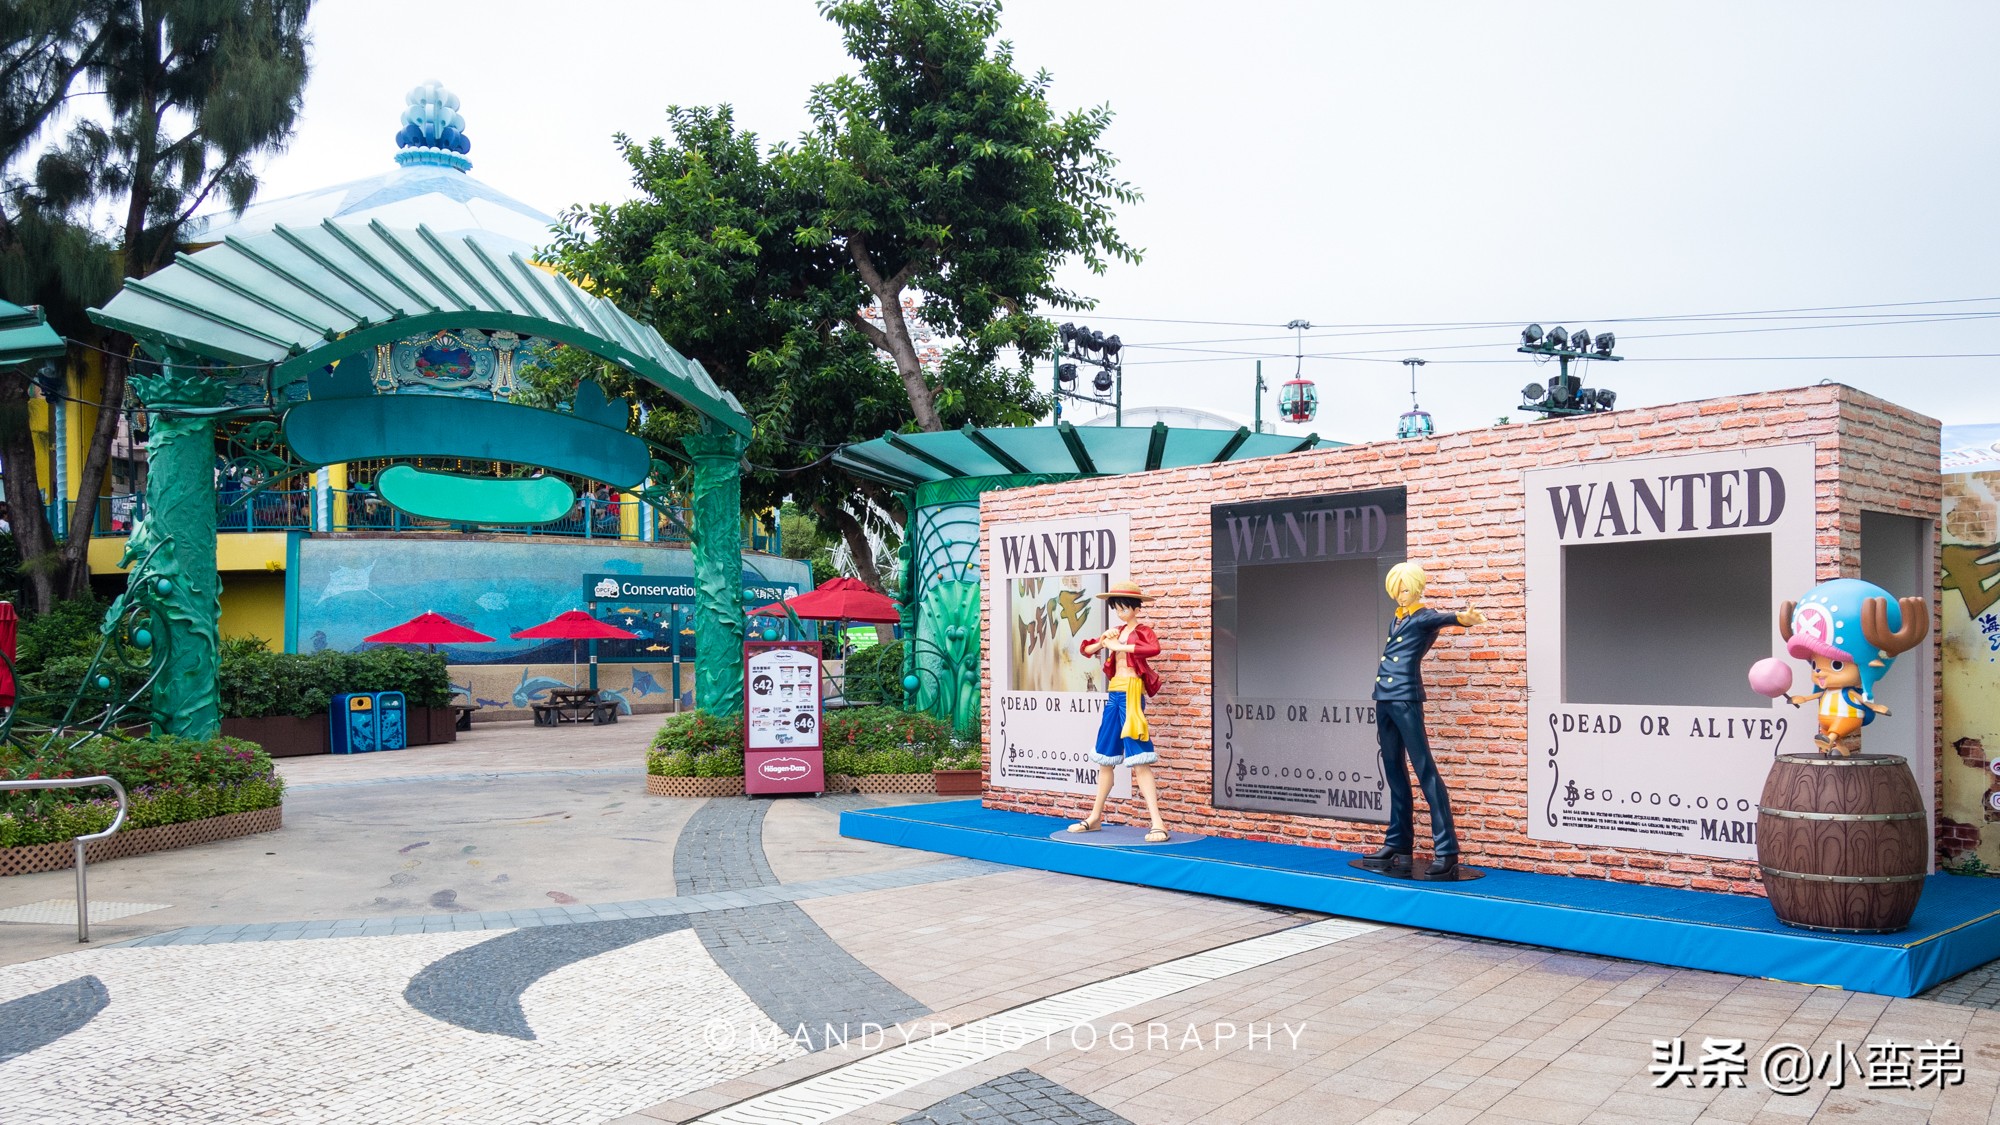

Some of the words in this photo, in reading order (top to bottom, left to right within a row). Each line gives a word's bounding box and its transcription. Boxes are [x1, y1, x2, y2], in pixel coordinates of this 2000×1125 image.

[1546, 467, 1785, 539] WANTED
[1226, 504, 1387, 561] WANTED
[1000, 528, 1117, 574] WANTED
[754, 679, 773, 690] $42
[1007, 696, 1038, 711] DEAD
[1046, 697, 1061, 712] OR
[1235, 703, 1276, 721] DEAD
[1287, 704, 1308, 722] OR
[1320, 706, 1376, 724] ALIVE
[795, 717, 814, 729] $46
[1562, 713, 1622, 733] DEAD
[1640, 715, 1670, 736] OR
[1689, 717, 1774, 740] ALIVE
[1327, 788, 1383, 811] MARINE
[1700, 818, 1757, 845] MARI
